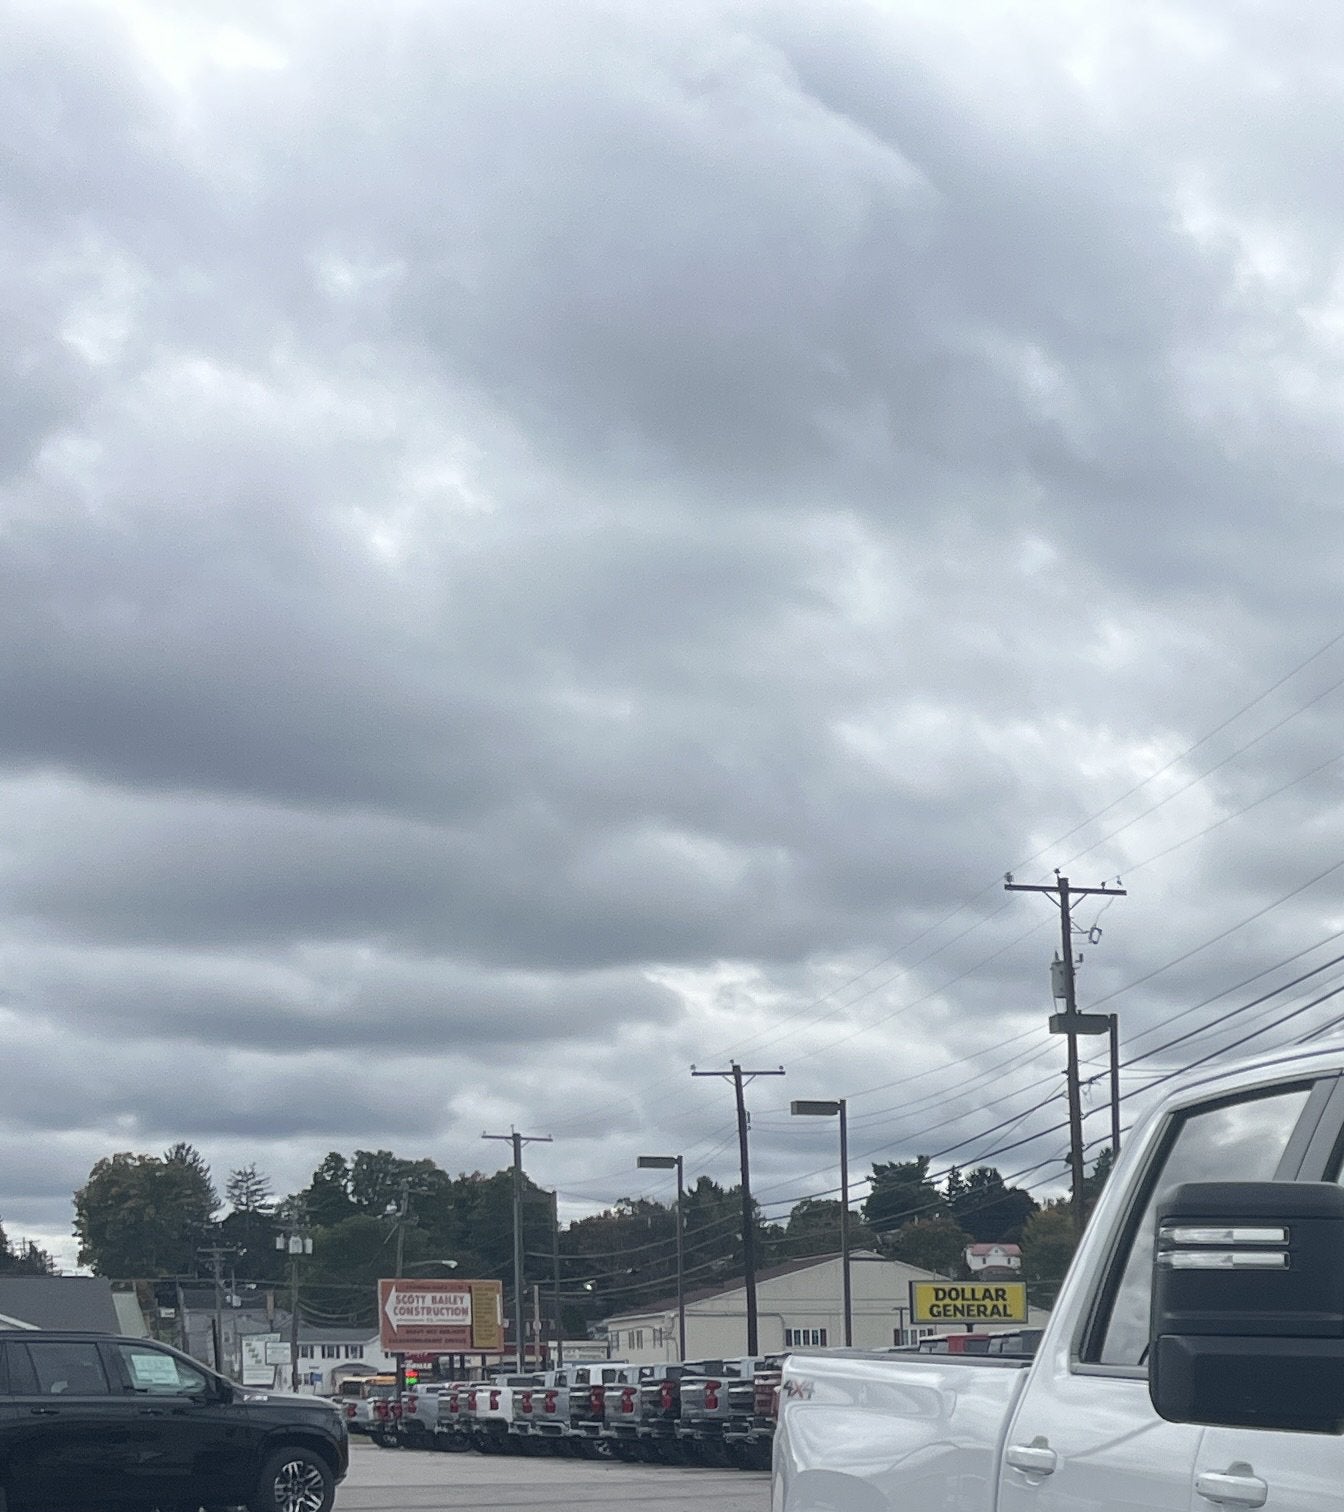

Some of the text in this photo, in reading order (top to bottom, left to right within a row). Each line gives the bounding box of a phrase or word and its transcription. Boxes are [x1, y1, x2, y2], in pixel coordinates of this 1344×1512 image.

[395, 1294, 465, 1305] SCOTT BAILEY
[933, 1287, 1008, 1302] DOLLAR
[393, 1306, 469, 1316] CONSTRUCTION
[929, 1303, 1013, 1318] GENERAL
